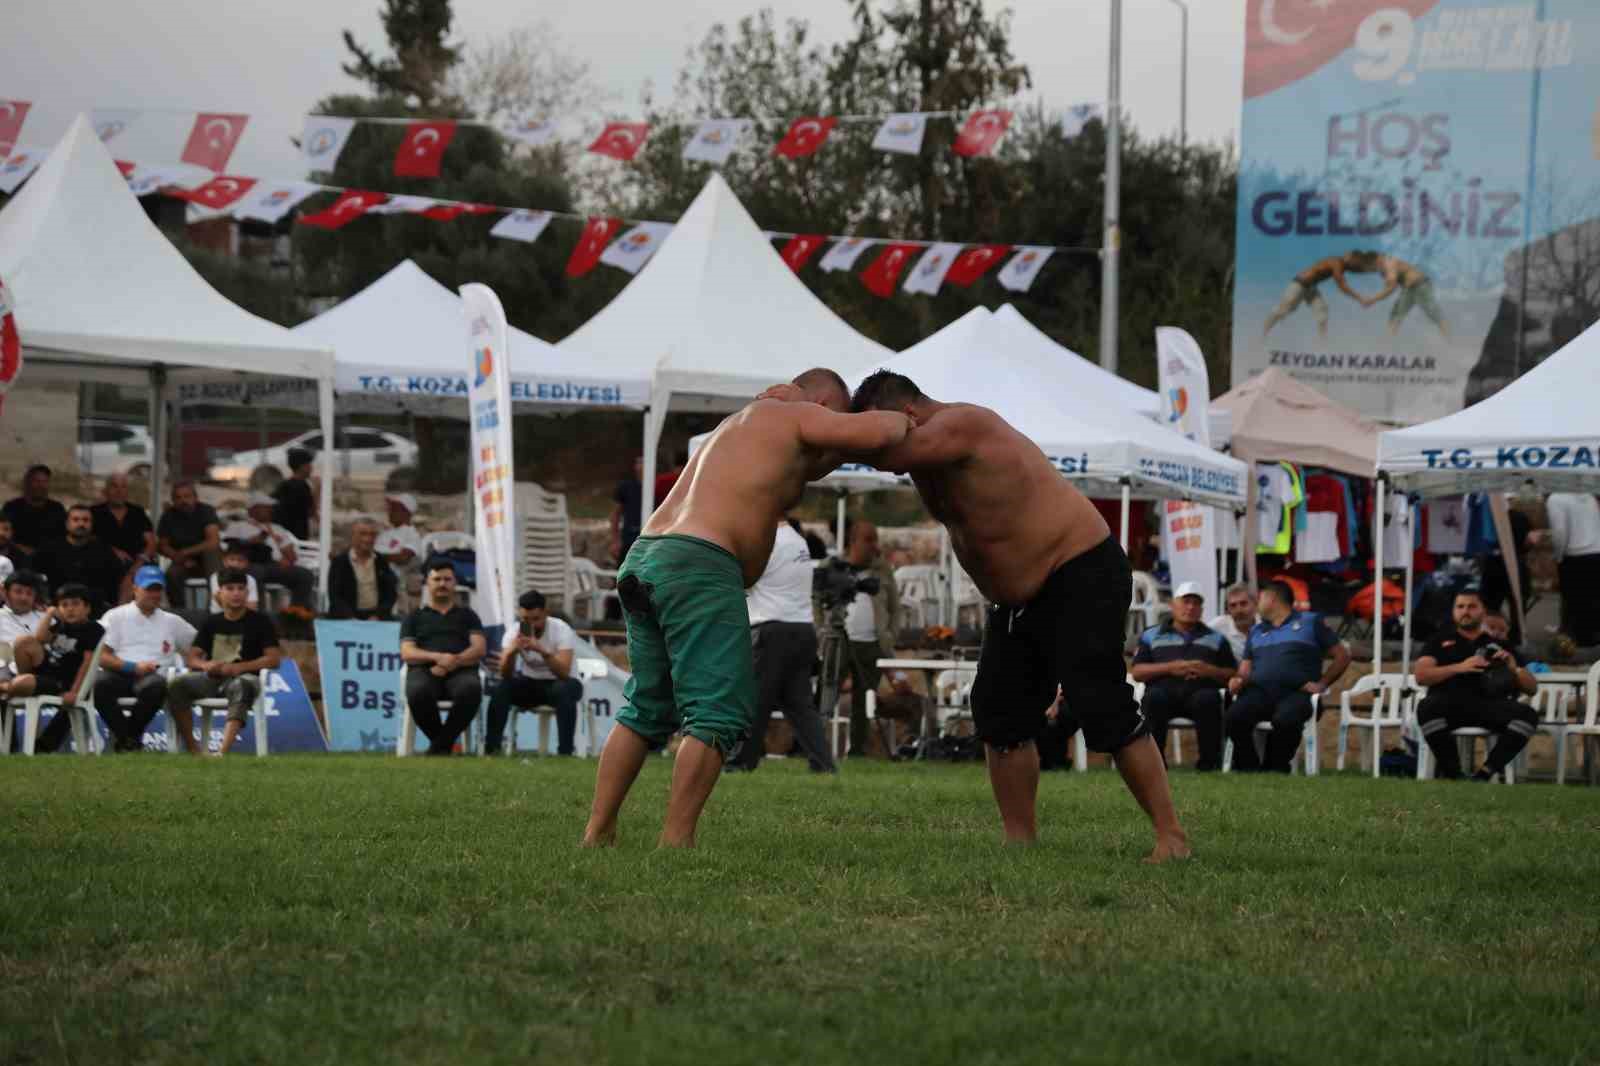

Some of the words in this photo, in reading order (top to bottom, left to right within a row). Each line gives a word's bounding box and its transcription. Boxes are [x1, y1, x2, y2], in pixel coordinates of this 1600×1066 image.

[1353, 8, 1416, 83] 9.
[1327, 112, 1451, 171] HOŞ
[1252, 176, 1521, 238] GELDİNİZ
[1269, 350, 1345, 370] ZEYDAN
[1349, 353, 1437, 371] KARALAR
[408, 376, 468, 394] KOZA
[511, 381, 622, 404] ELEDİYESİ
[1421, 449, 1483, 469] T.C.
[1497, 447, 1600, 468] KOZA
[334, 640, 402, 672] Tüm
[341, 680, 400, 719] Baş
